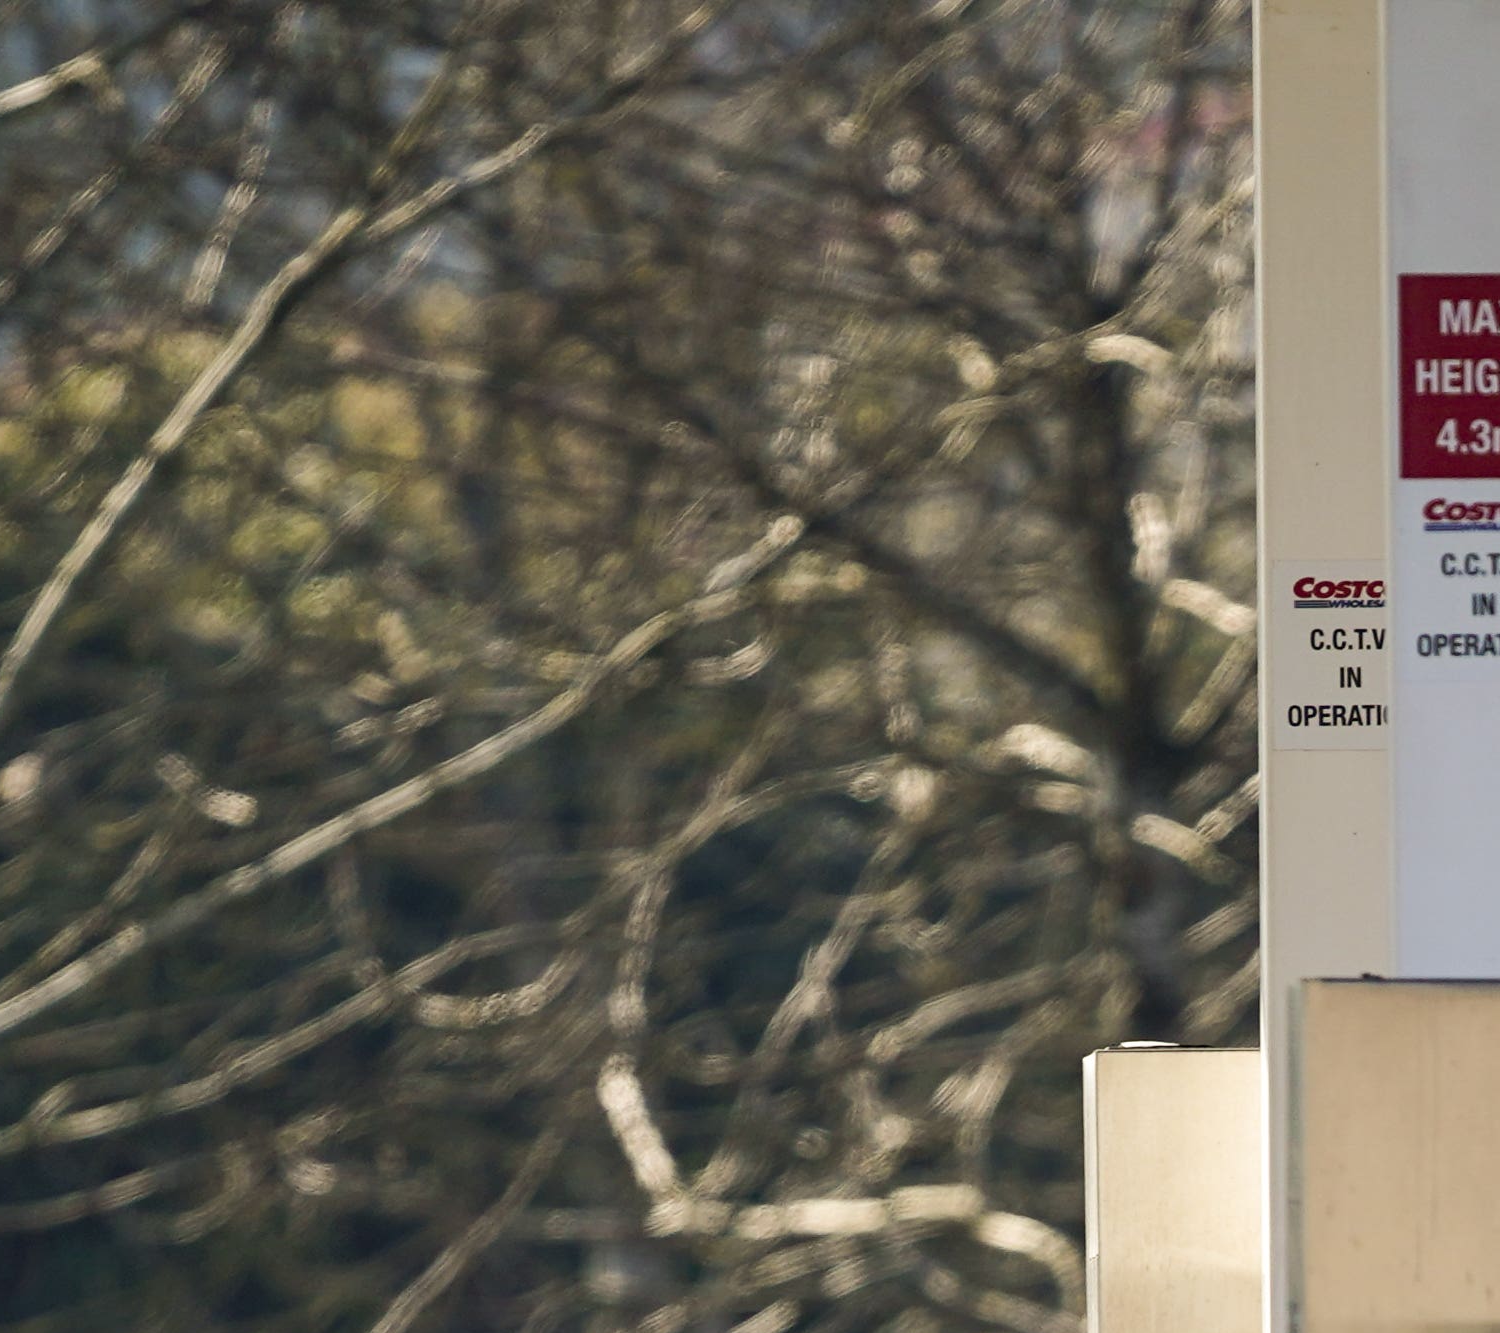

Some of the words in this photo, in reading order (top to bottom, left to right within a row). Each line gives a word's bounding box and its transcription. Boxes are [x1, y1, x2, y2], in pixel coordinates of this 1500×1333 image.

[1293, 577, 1385, 599] COSTC
[1328, 600, 1385, 608] WHOLES
[1471, 593, 1496, 616] IN
[1310, 628, 1385, 650] C.C.T.V
[1339, 667, 1362, 688] IN
[1288, 705, 1388, 727] OPERATI
